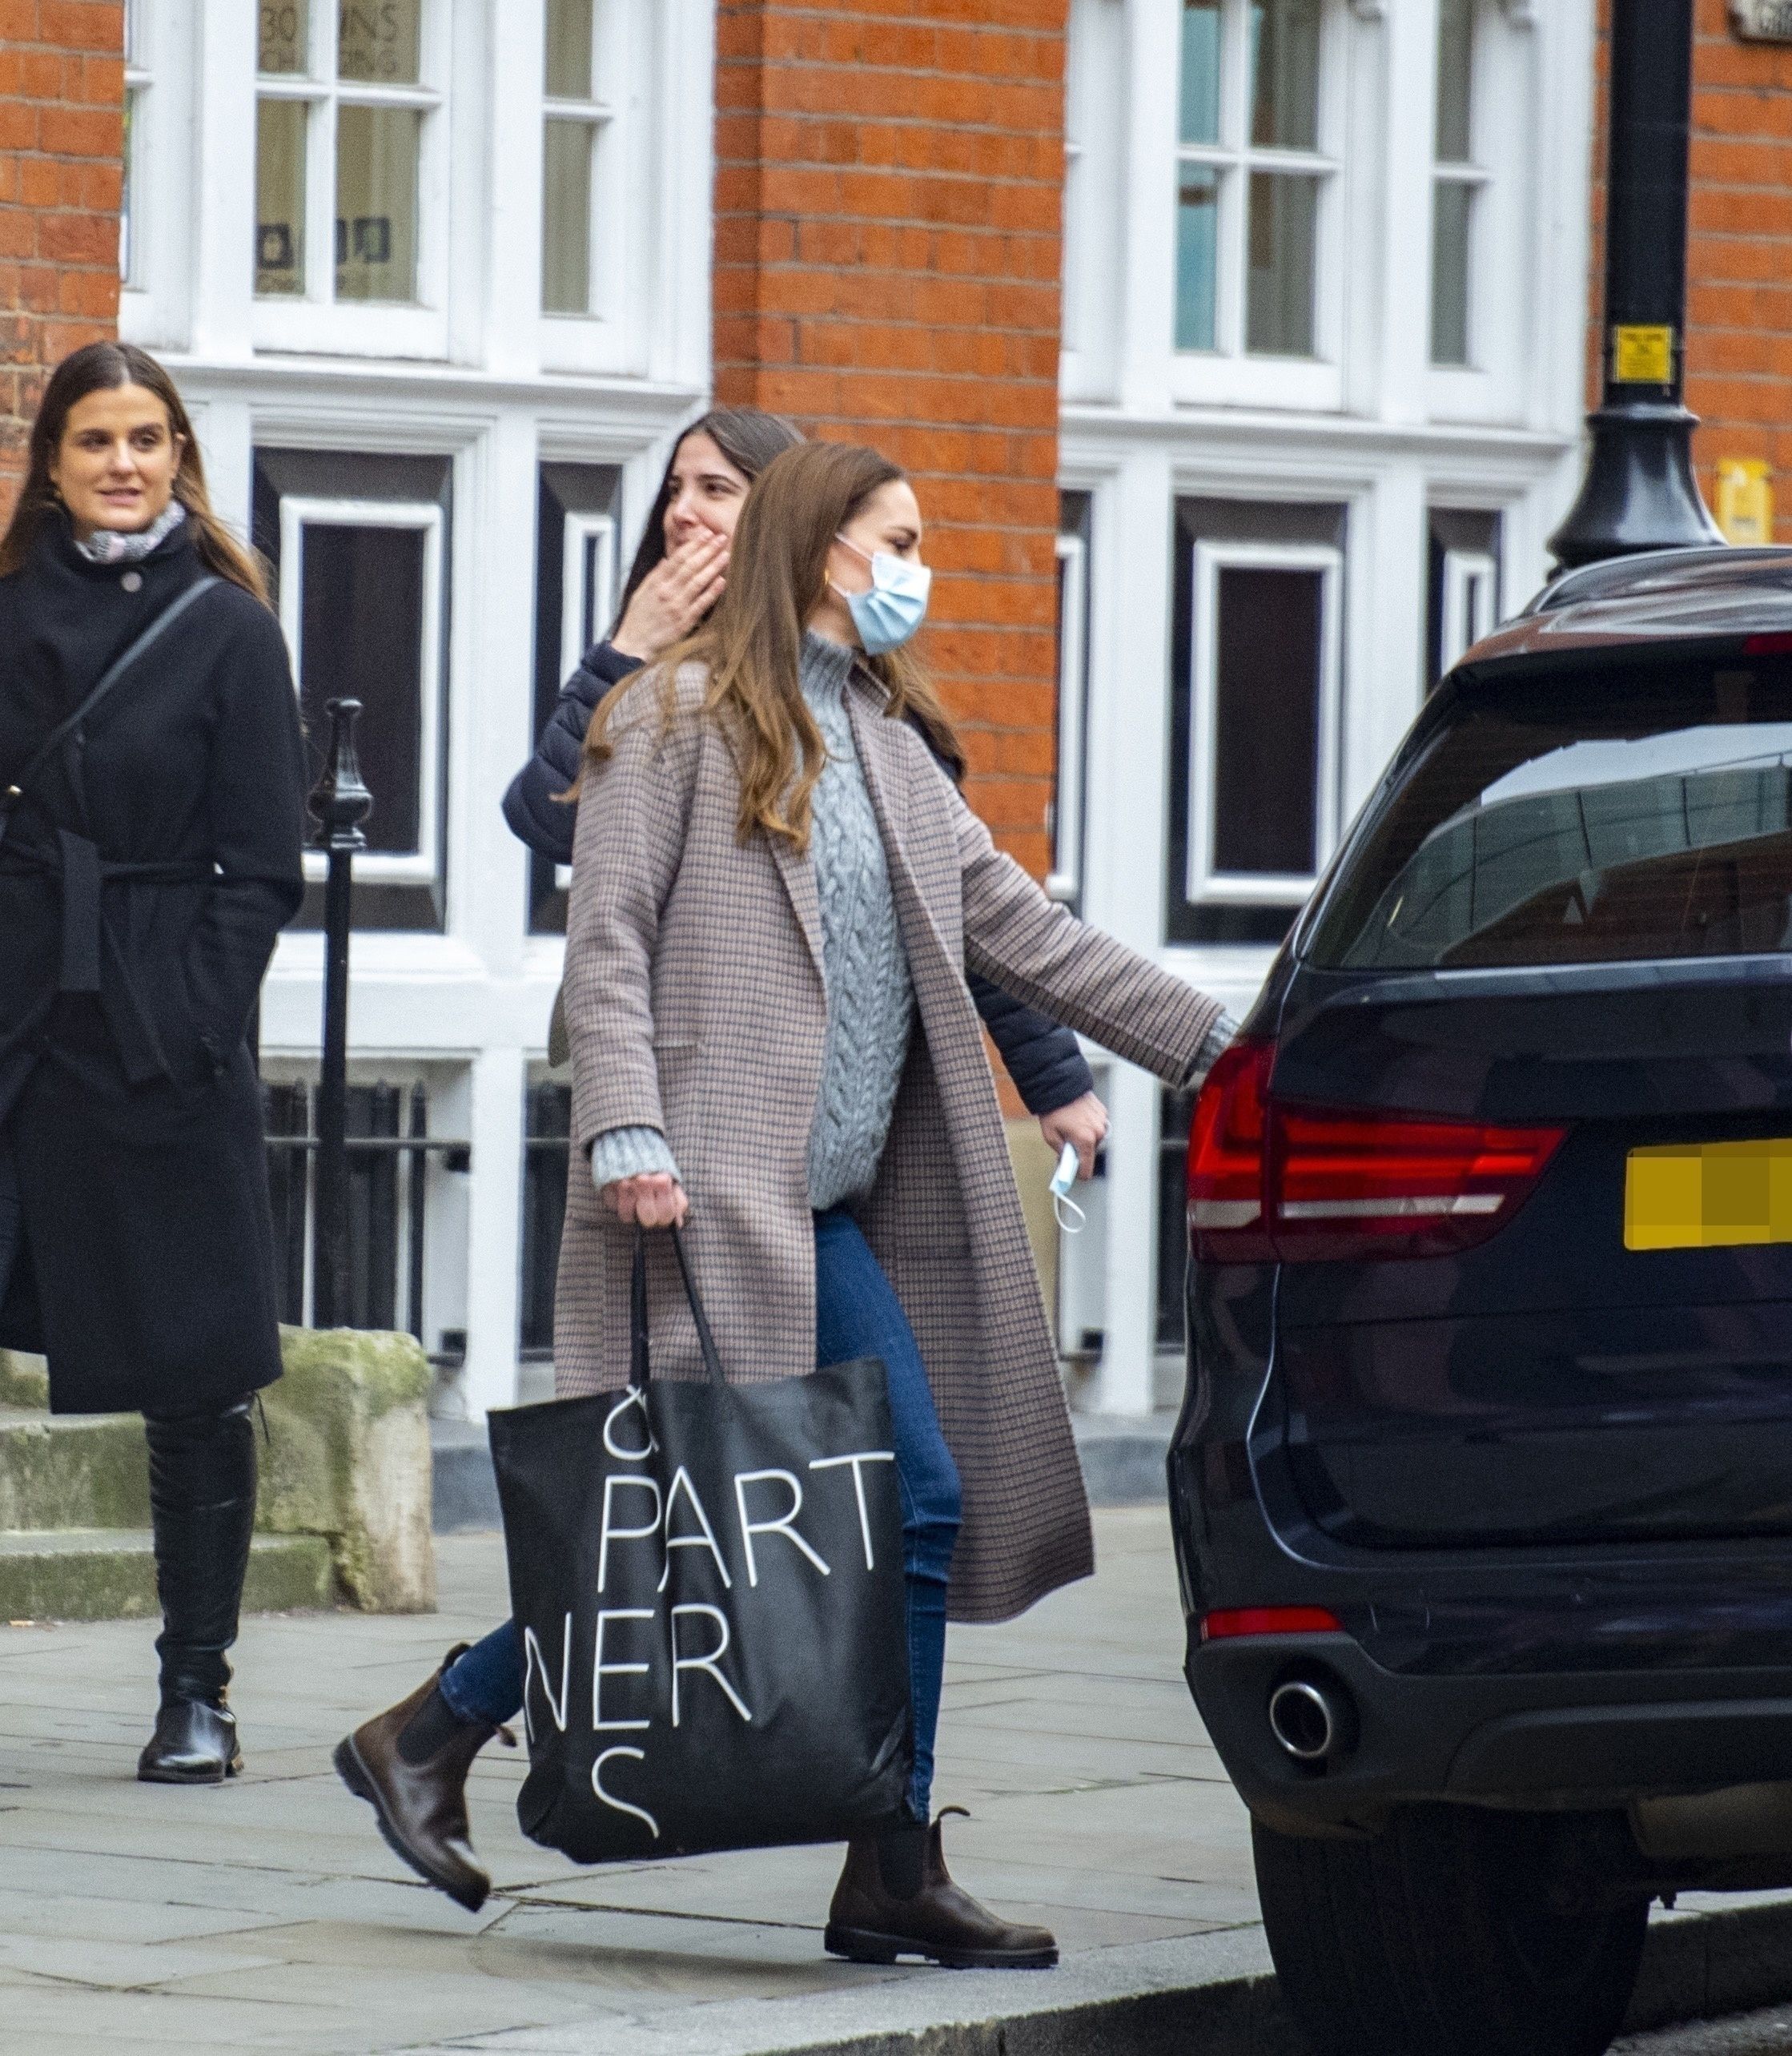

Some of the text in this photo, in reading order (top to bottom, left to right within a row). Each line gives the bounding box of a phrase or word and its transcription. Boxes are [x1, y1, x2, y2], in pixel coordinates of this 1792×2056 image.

[597, 1451, 896, 1593] PART
[524, 1603, 753, 1744] NER
[591, 1745, 660, 1839] S
